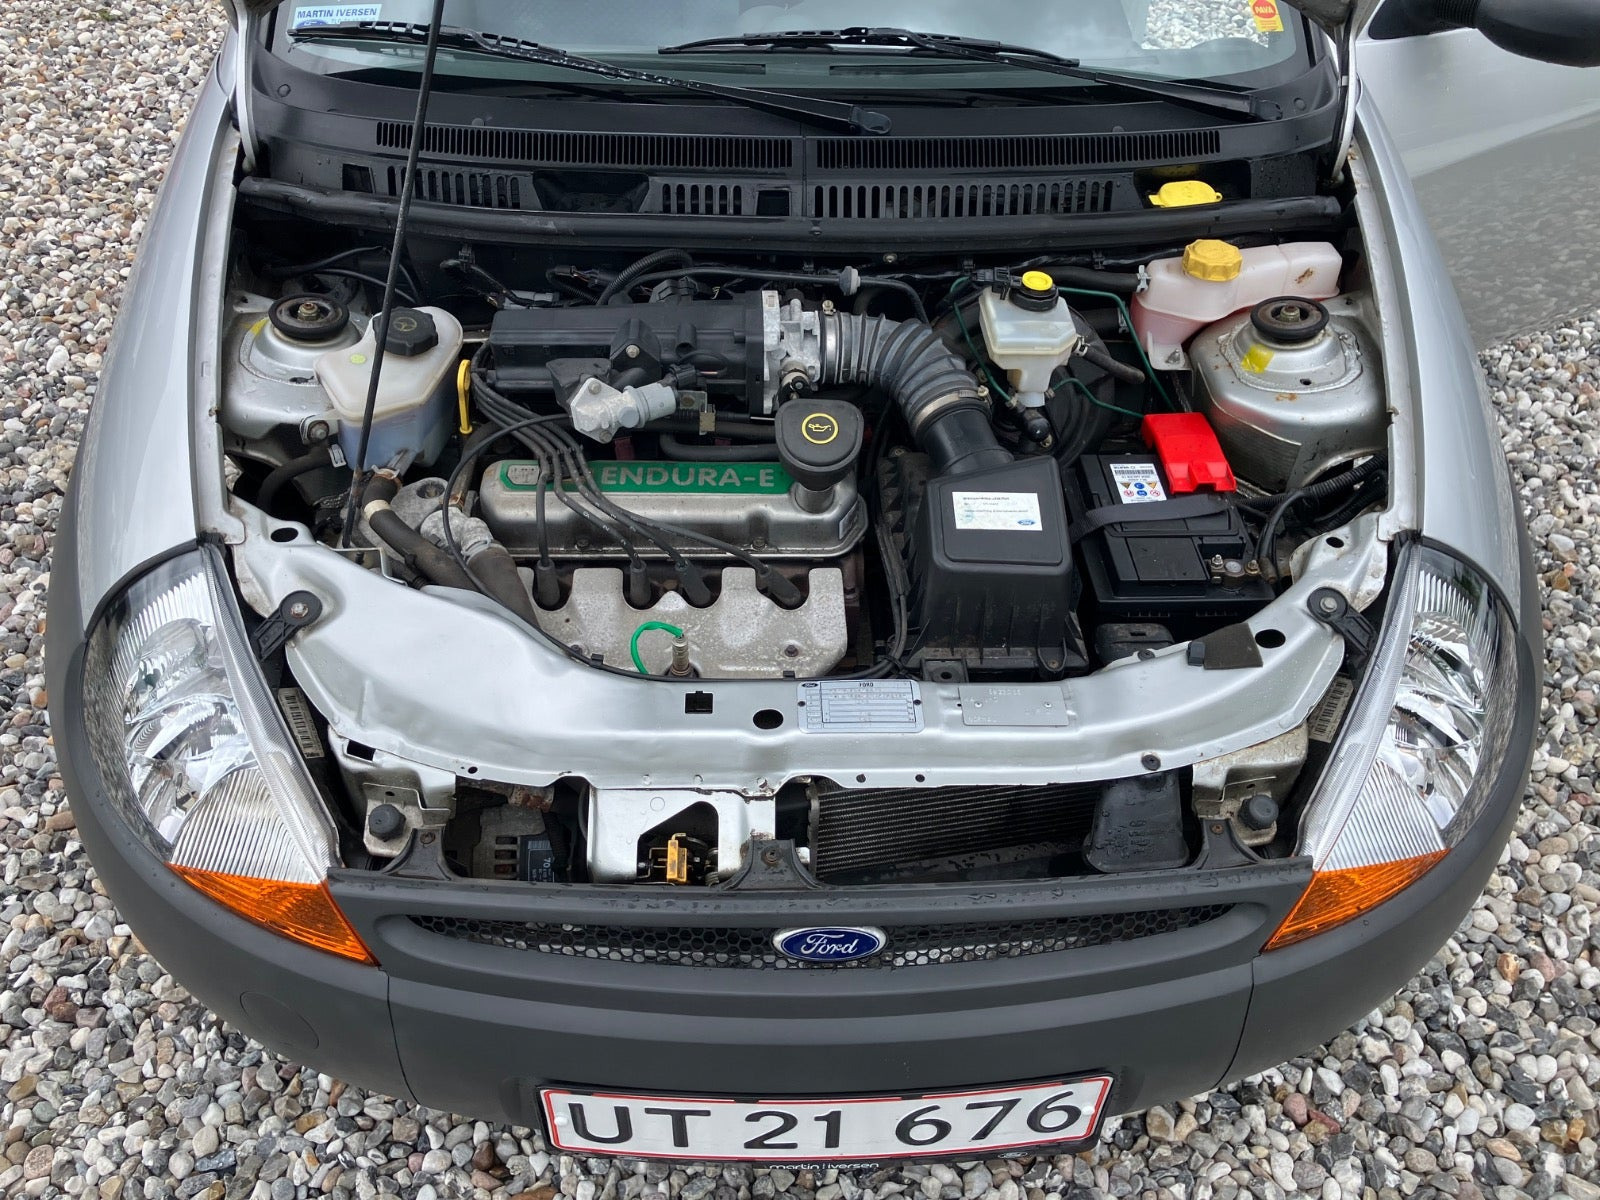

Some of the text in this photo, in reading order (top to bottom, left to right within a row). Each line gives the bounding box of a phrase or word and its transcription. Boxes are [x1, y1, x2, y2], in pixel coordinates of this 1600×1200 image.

[297, 7, 377, 19] MARTIN IVERSEN
[600, 466, 775, 488] ENDURA-E
[800, 933, 860, 955] Ford
[567, 1090, 1084, 1149] UT 21 676
[827, 1162, 880, 1170] iversen
